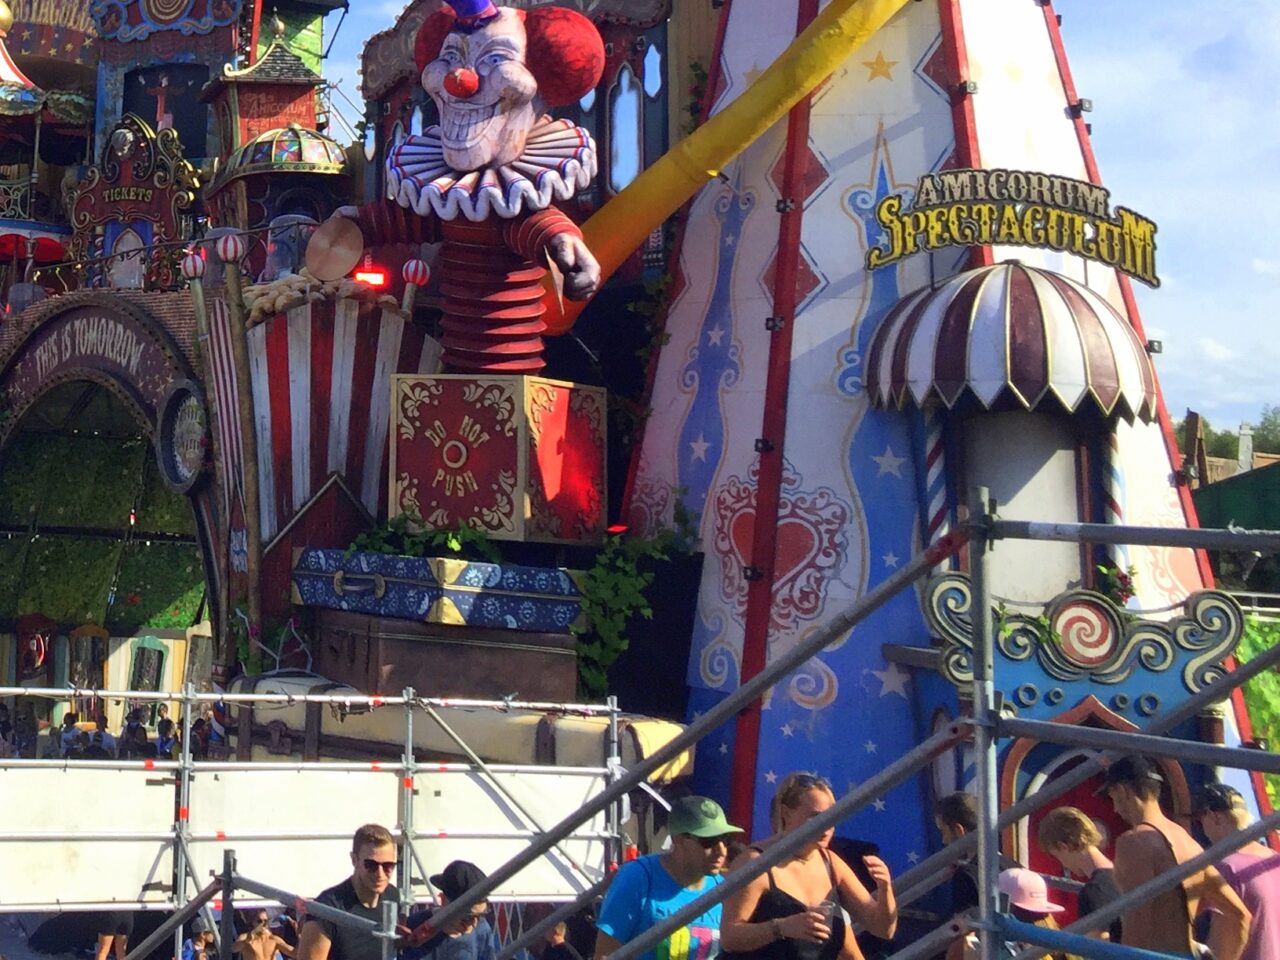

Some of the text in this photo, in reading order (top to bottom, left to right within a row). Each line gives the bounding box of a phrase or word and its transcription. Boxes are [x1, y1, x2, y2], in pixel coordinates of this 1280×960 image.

[102, 187, 153, 203] TICKETS
[916, 171, 1108, 217] AMICORUM
[868, 198, 1160, 287] SPECTACULUM
[33, 317, 146, 380] THIS IS TOMORROW
[424, 415, 491, 449] DO NOT
[431, 468, 479, 497] PUSH
